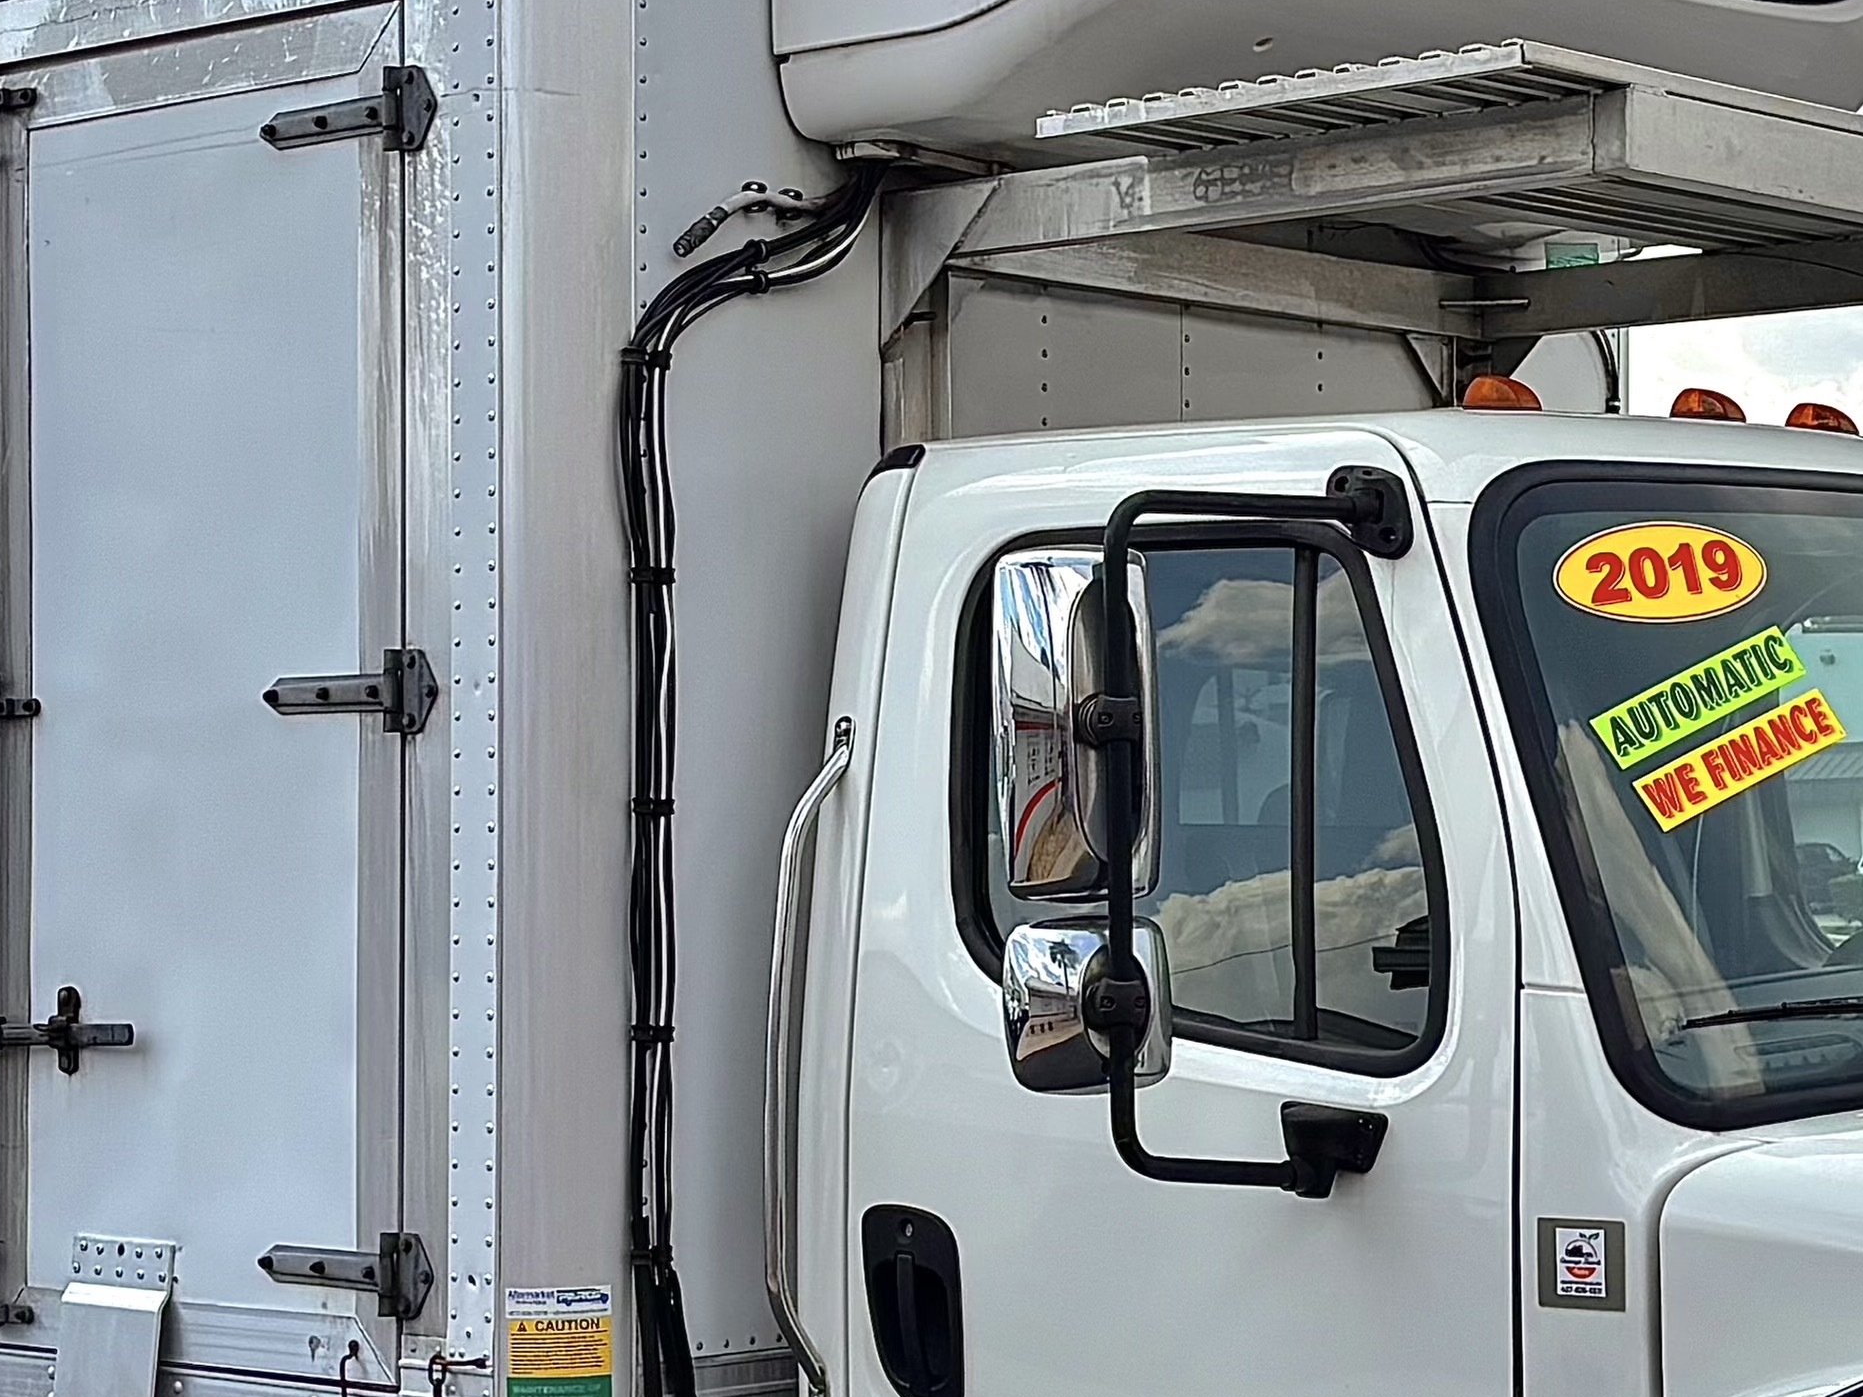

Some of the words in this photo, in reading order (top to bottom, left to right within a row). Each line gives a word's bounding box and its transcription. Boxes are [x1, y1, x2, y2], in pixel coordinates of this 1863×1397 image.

[1585, 540, 1743, 606] 2019
[1609, 634, 1795, 757] AUTOMATIC
[1642, 763, 1708, 819] WE
[1701, 697, 1836, 790] FINANCE
[535, 1319, 601, 1332] CAUTION
